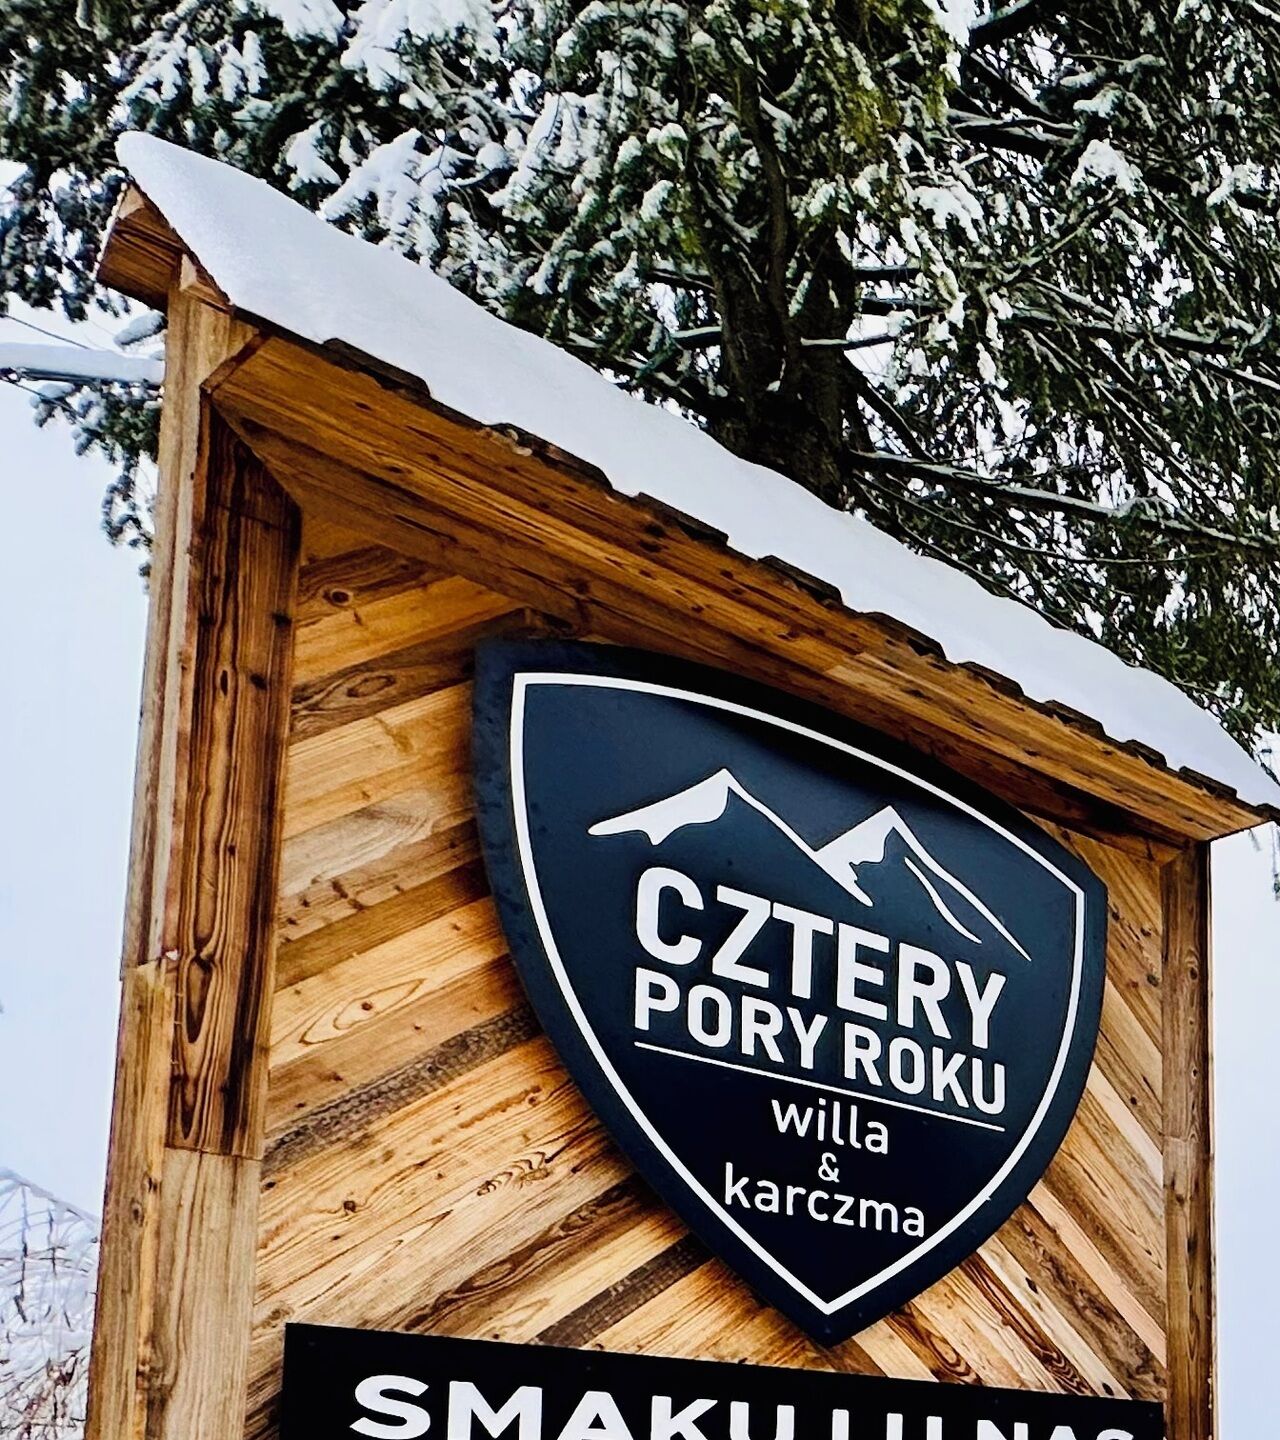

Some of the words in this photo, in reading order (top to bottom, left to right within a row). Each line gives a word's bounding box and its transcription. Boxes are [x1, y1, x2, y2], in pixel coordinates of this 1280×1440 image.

[635, 866, 1007, 1050] CZTERY
[634, 967, 828, 1070] PORY
[843, 1021, 1006, 1115] ROKU
[771, 1098, 889, 1155] willa
[724, 1161, 925, 1238] karczma
[817, 1152, 840, 1183] &
